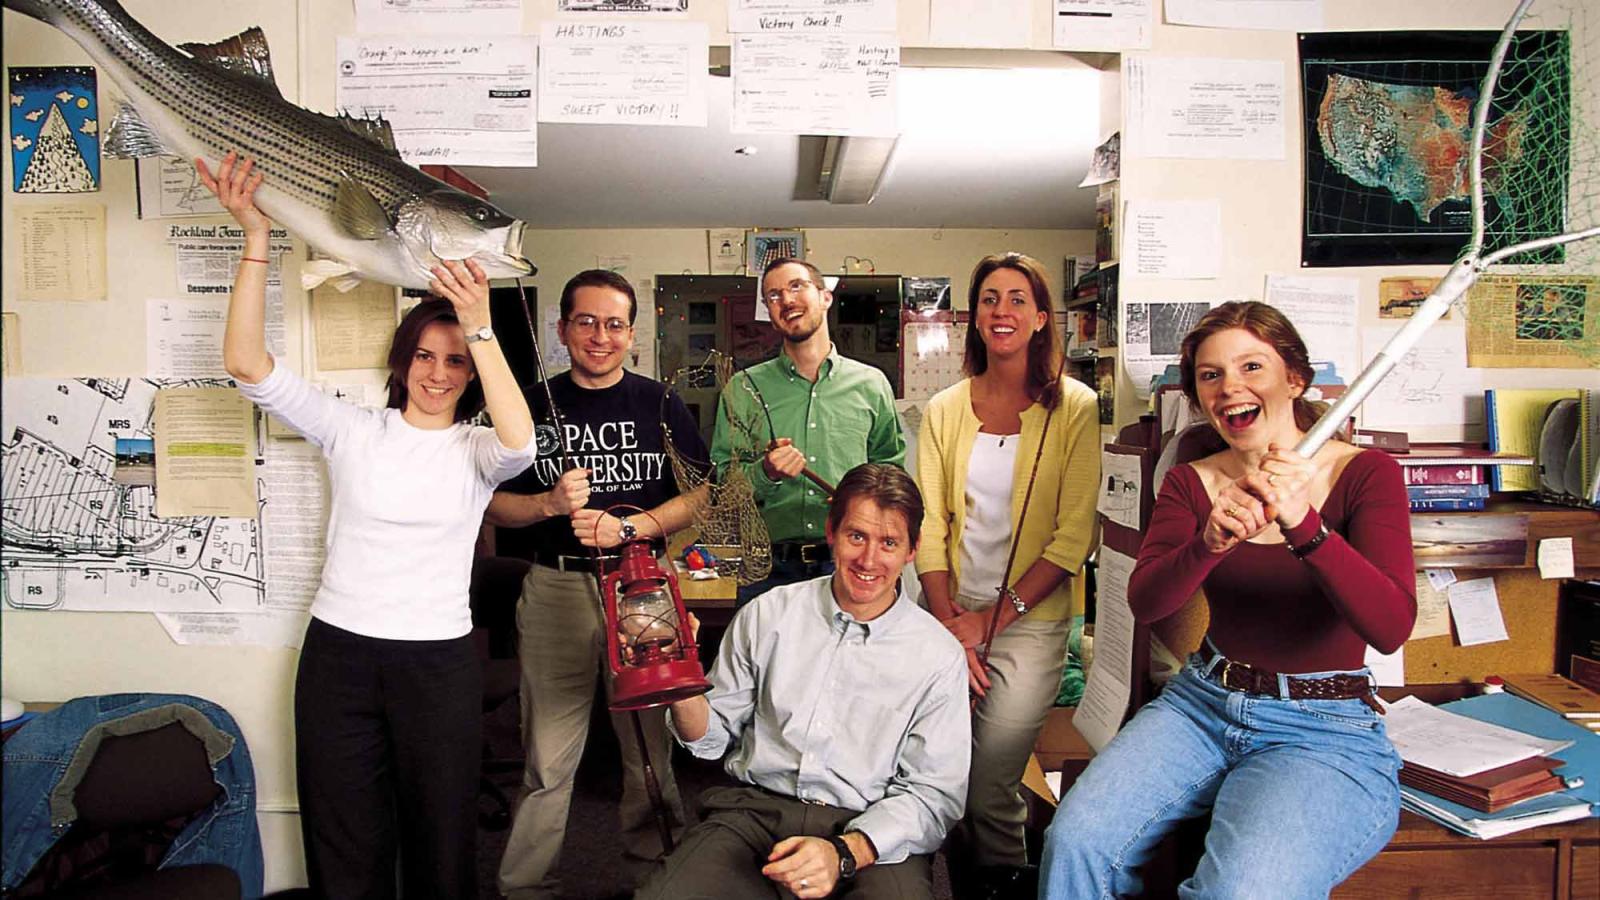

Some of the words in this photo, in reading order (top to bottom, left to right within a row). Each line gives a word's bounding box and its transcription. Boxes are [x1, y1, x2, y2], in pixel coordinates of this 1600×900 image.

[759, 17, 794, 29] Victory
[803, 15, 829, 28] Check
[555, 25, 625, 38] HASTINGS
[561, 103, 606, 116] SWEET
[616, 103, 665, 116] VICTORY
[171, 225, 216, 238] Rockland
[187, 284, 228, 294] Desperate
[108, 419, 131, 429] MRS
[563, 421, 638, 453] PACE
[534, 452, 667, 487] UNVERSITY
[606, 484, 619, 492] OF
[622, 483, 643, 491] LAW
[89, 500, 103, 510] RS
[28, 585, 43, 595] RS
